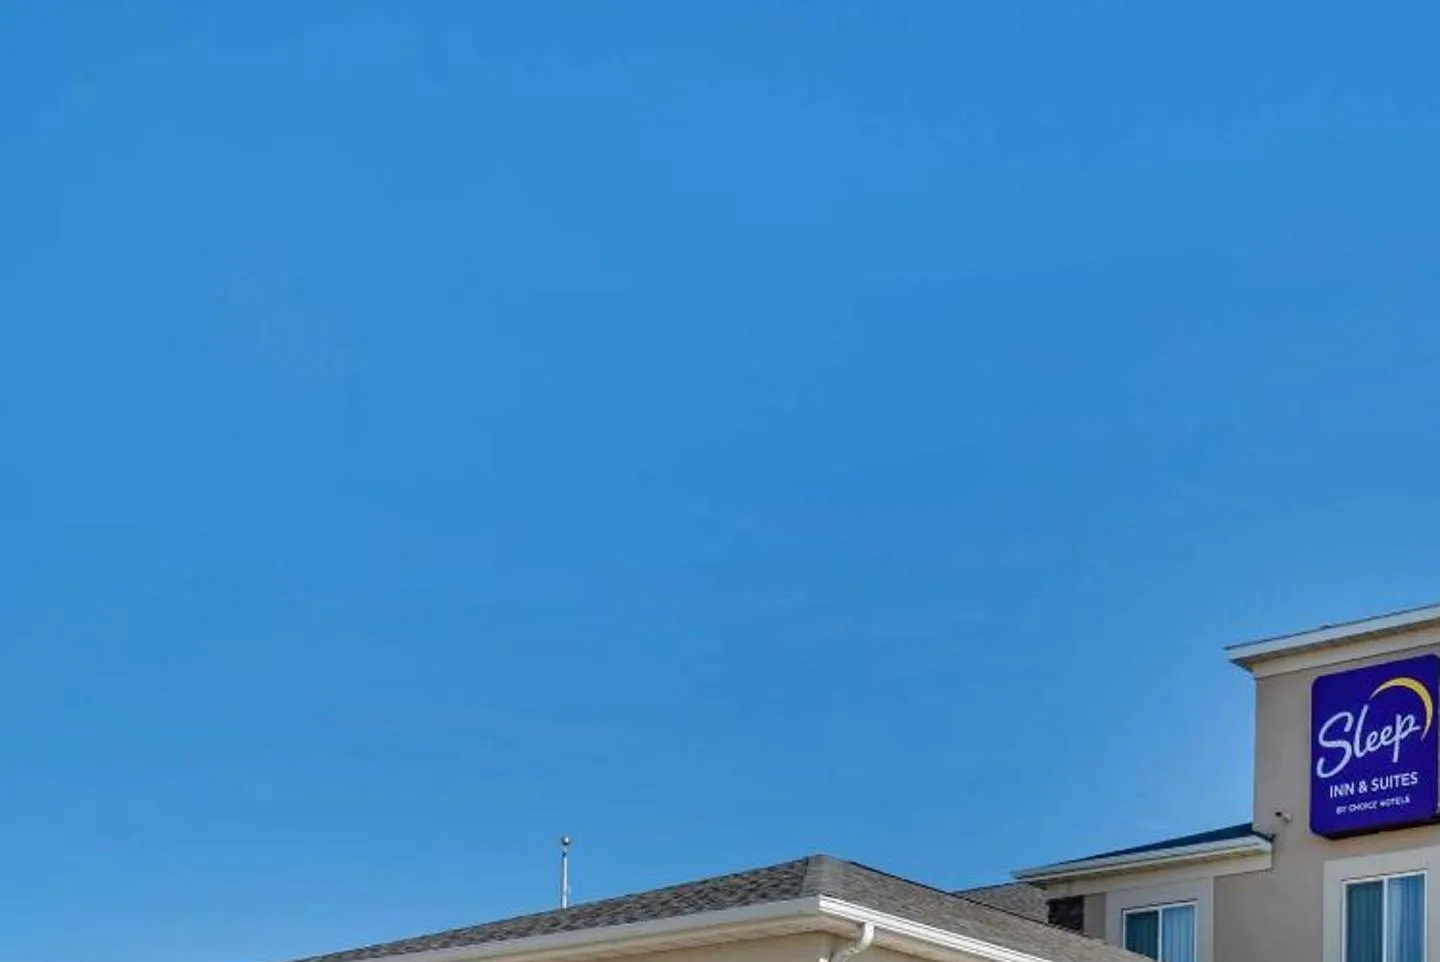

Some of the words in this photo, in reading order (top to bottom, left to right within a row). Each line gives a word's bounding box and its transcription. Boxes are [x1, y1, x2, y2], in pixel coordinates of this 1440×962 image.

[1316, 703, 1421, 779] Sleep
[1329, 782, 1355, 799] INN
[1358, 780, 1368, 794] &
[1371, 771, 1419, 792] SUITES
[1348, 800, 1378, 813] CHOICE
